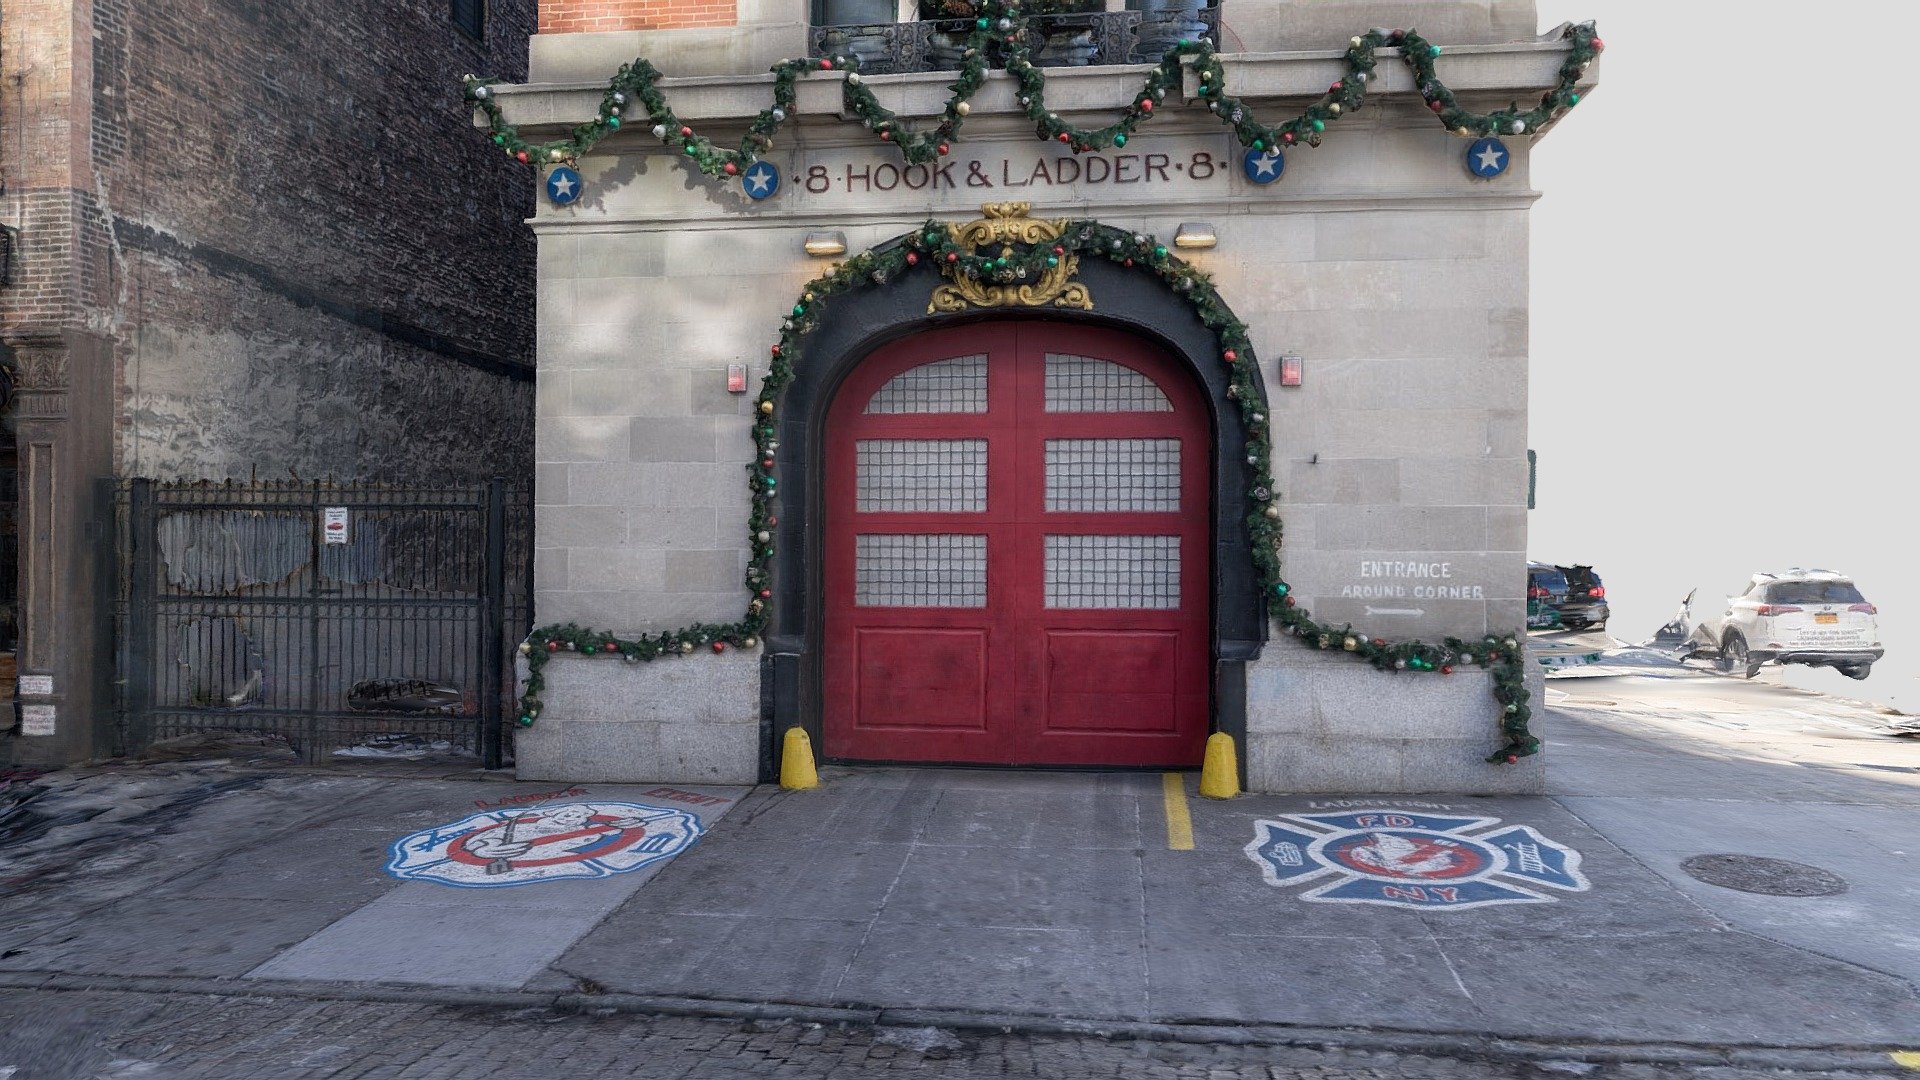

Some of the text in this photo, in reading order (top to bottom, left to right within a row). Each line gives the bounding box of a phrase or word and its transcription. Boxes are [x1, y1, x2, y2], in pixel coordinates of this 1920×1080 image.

[846, 161, 957, 192] HOOK
[966, 160, 993, 187] &
[1003, 153, 1170, 187] LADDER
[1360, 560, 1451, 578] ENTRANCE
[1342, 584, 1484, 599] AROUND CORNER
